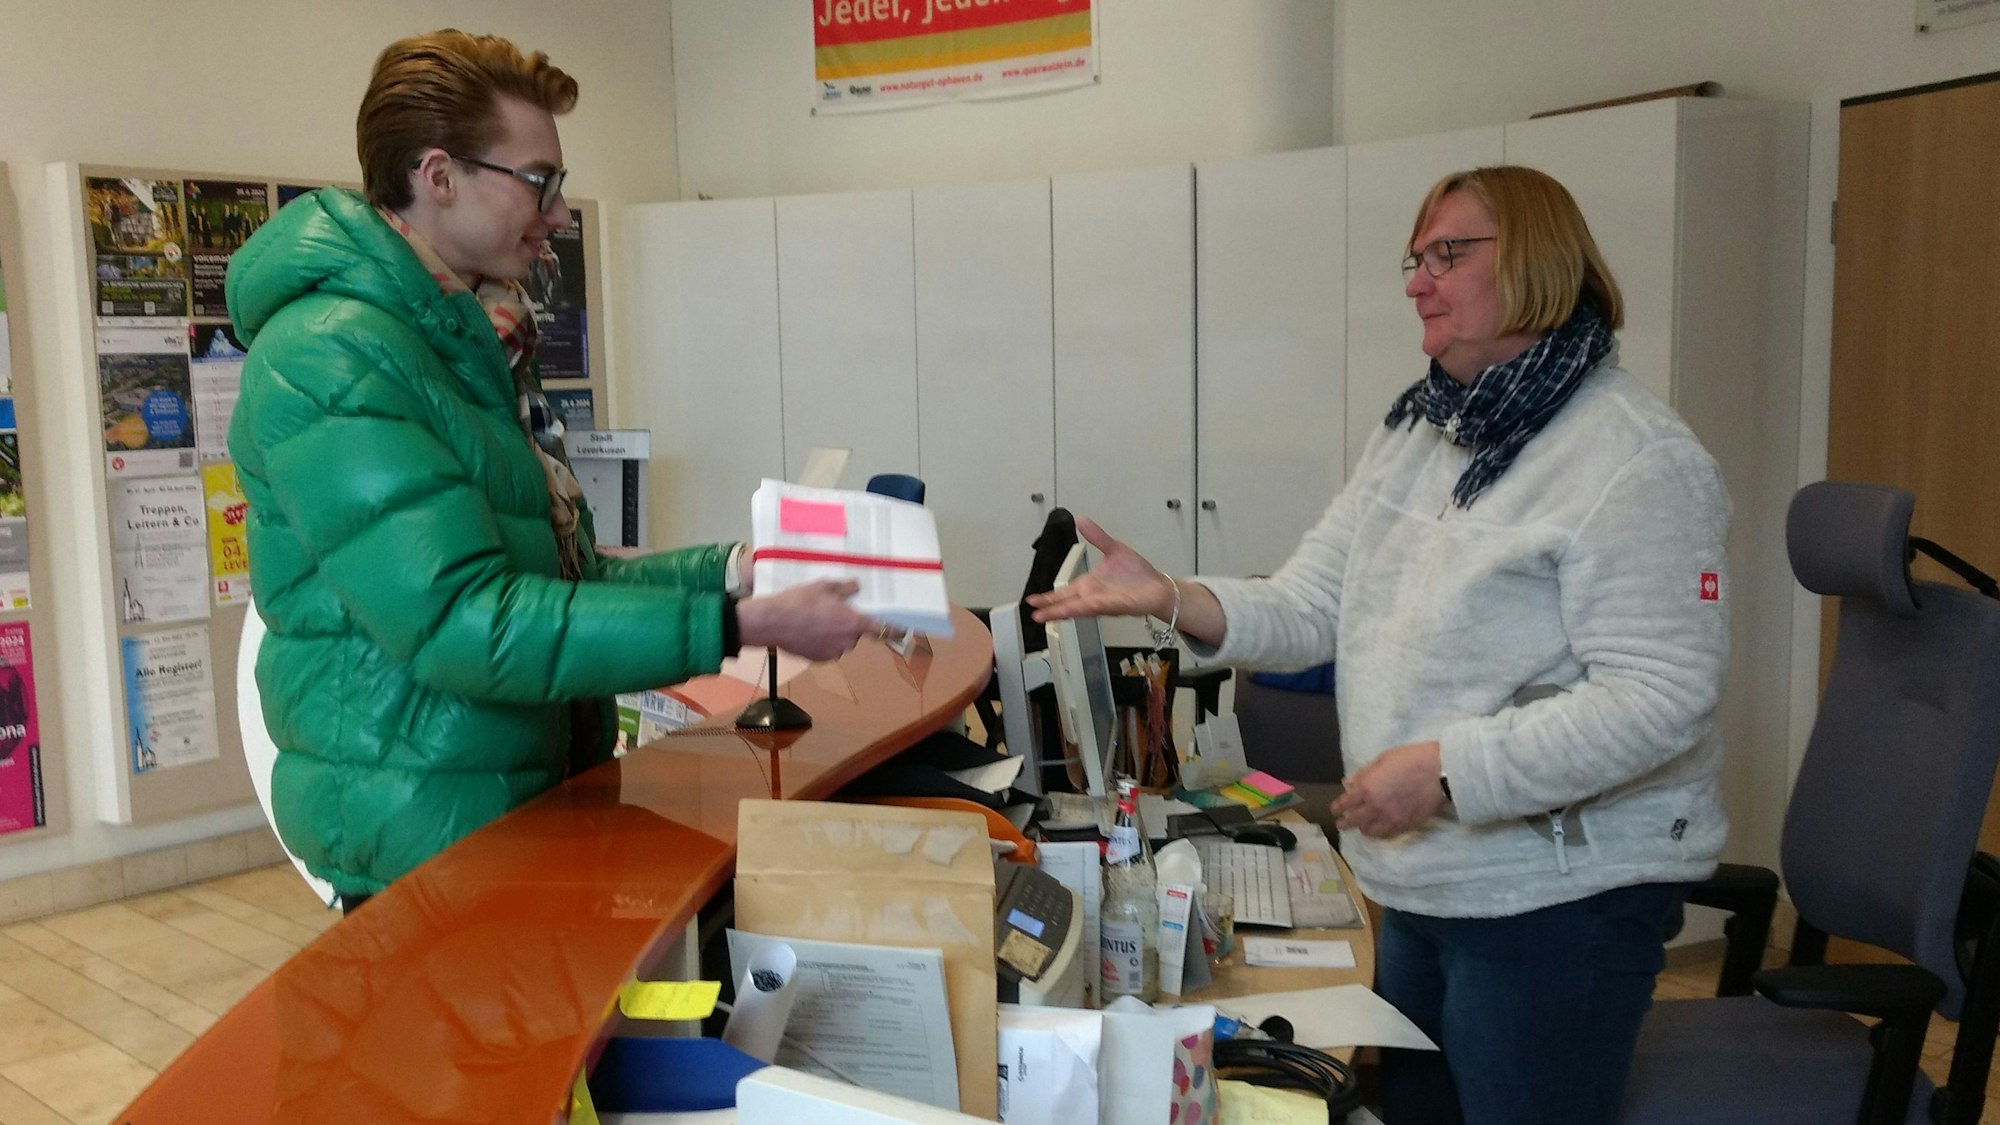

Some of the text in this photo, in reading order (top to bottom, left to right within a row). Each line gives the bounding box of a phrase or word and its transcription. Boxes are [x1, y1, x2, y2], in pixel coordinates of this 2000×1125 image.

[590, 433, 613, 442] Stadt
[577, 446, 626, 454] Leverkusen
[139, 504, 188, 517] Treppen,
[127, 518, 169, 530] Leitern
[172, 516, 180, 527] &
[135, 659, 203, 679] Alle Register!
